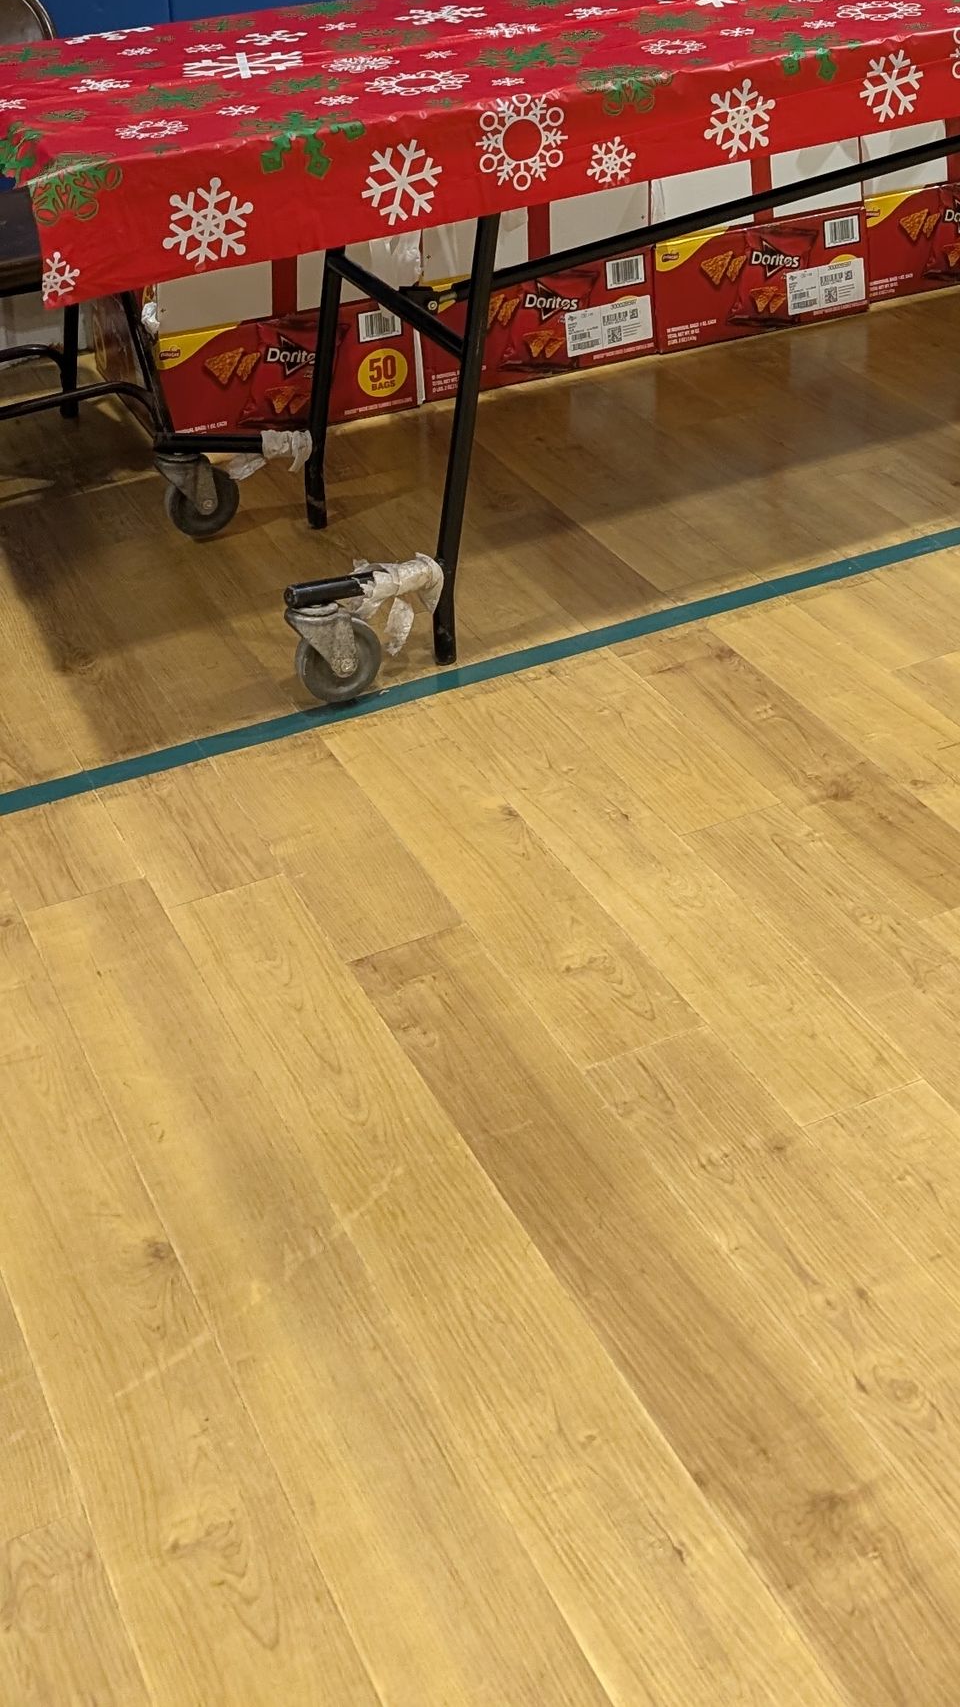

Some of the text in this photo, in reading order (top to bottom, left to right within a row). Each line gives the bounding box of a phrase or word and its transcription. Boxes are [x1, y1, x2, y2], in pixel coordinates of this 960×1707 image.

[751, 250, 800, 268] Doritos
[524, 293, 578, 311] Doritos
[369, 354, 397, 383] 50
[371, 379, 396, 391] BAGS
